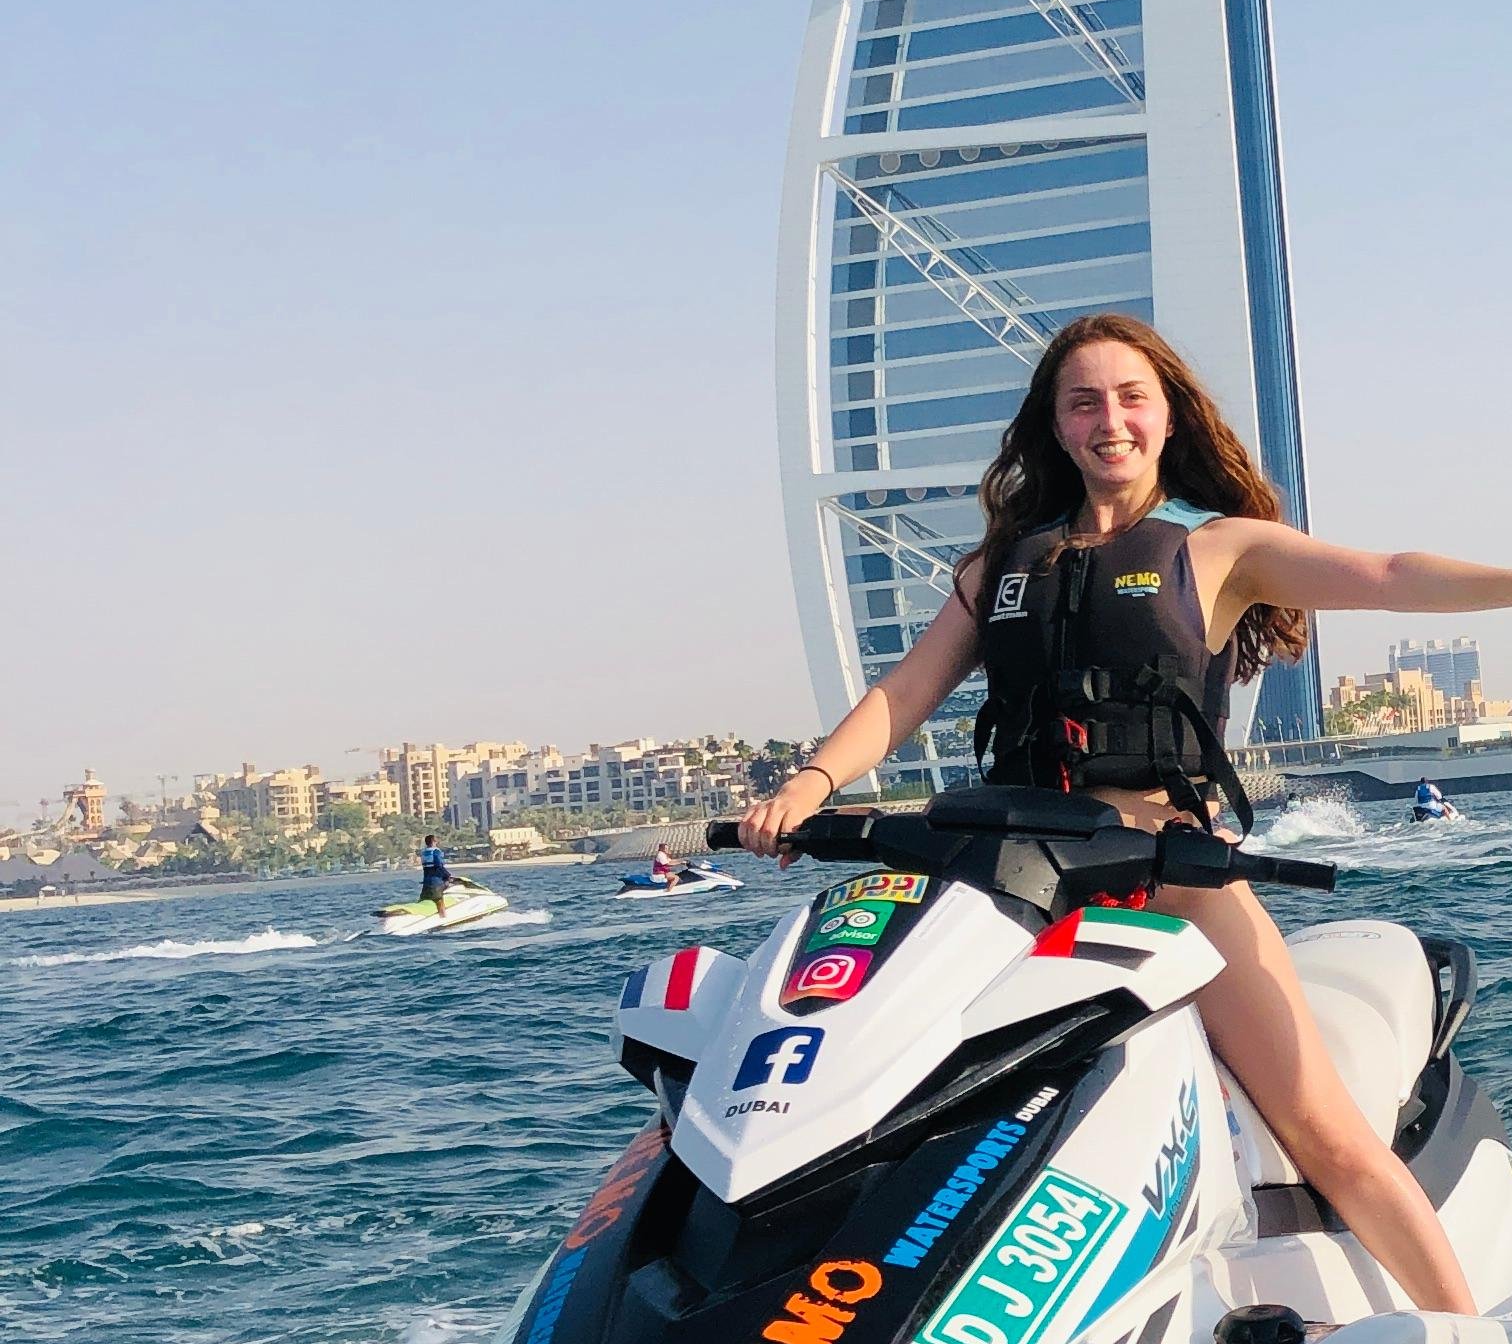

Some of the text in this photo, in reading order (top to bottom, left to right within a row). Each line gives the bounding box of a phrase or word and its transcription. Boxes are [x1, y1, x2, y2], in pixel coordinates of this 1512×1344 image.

[1114, 571, 1162, 589] NEMO
[828, 928, 878, 942] advisor
[724, 1099, 791, 1118] DUBAI
[883, 1120, 1027, 1269] WATERSPORTS
[1014, 1086, 1060, 1122] DUBAI
[996, 1183, 1104, 1284] 3054
[977, 1274, 1034, 1318] J
